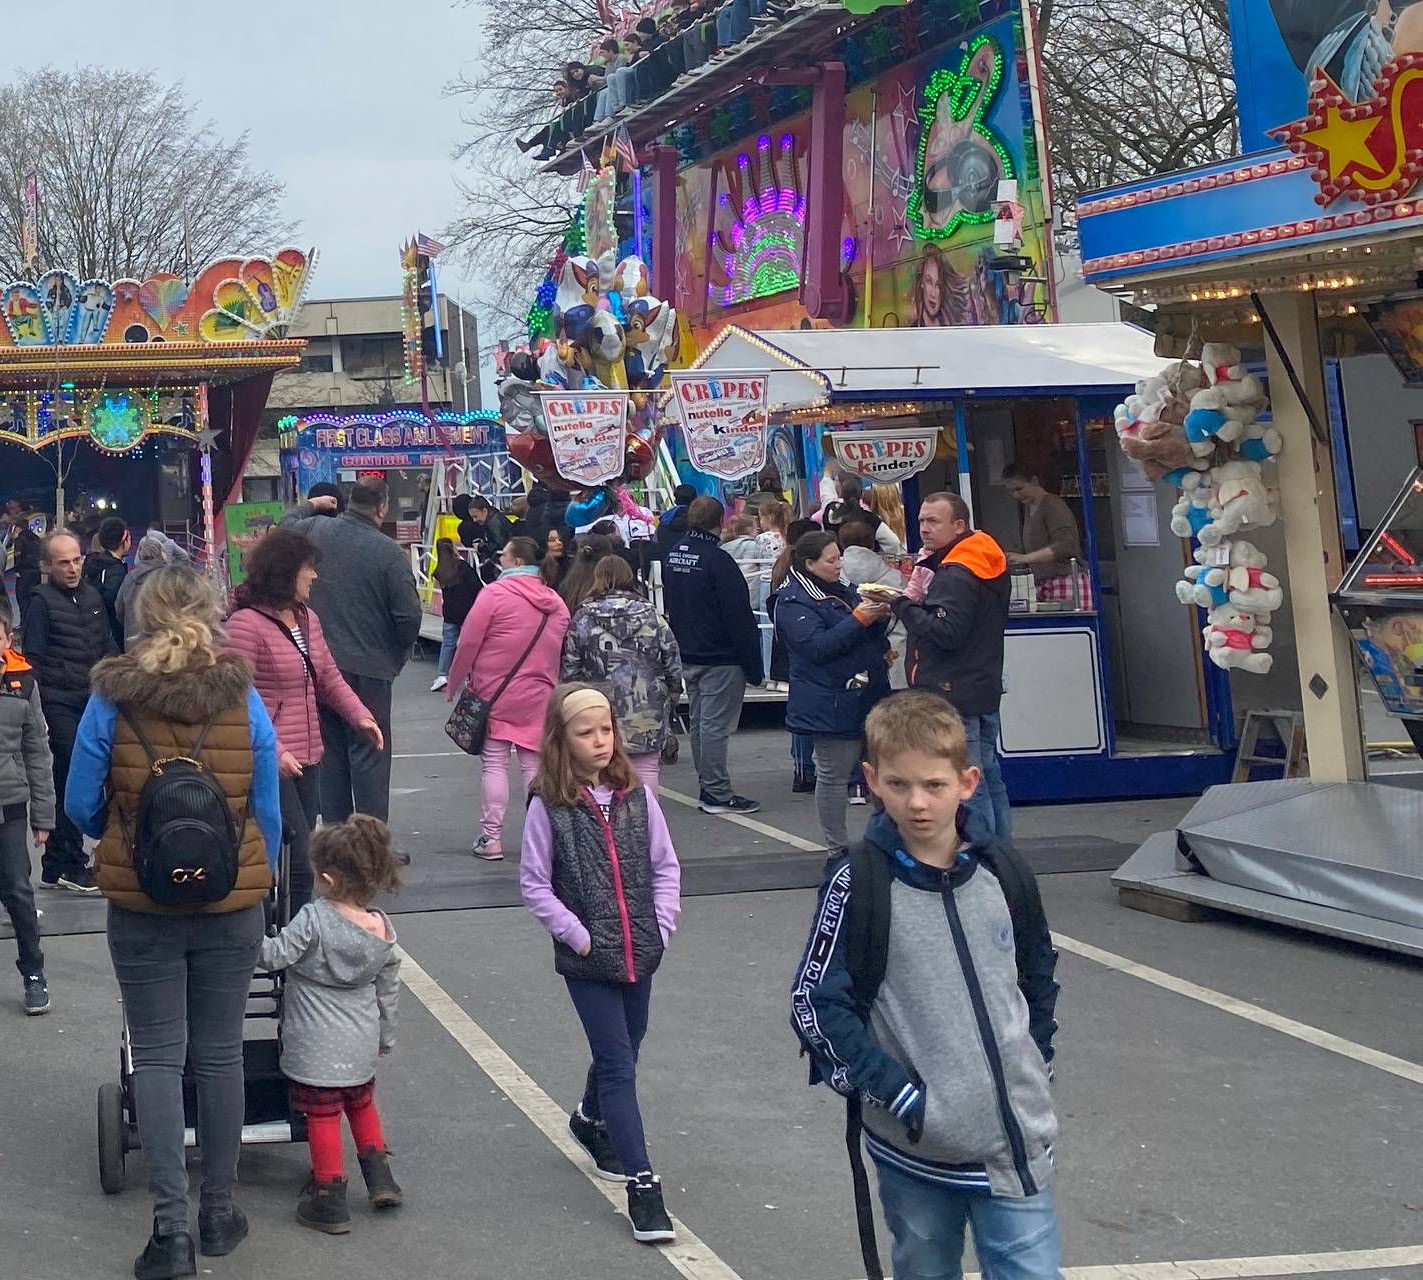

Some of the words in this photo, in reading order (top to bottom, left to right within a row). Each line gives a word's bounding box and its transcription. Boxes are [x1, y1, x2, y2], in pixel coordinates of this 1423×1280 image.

[688, 408, 732, 420] nutella
[554, 421, 593, 432] nutella
[713, 424, 763, 435] kinder
[316, 428, 354, 448] FIRST
[356, 427, 401, 446] CLASS
[574, 434, 620, 446] kinder
[341, 454, 412, 466] CONTROL
[857, 459, 916, 474] kinder
[806, 961, 822, 980] CO
[820, 886, 845, 936] PETROL
